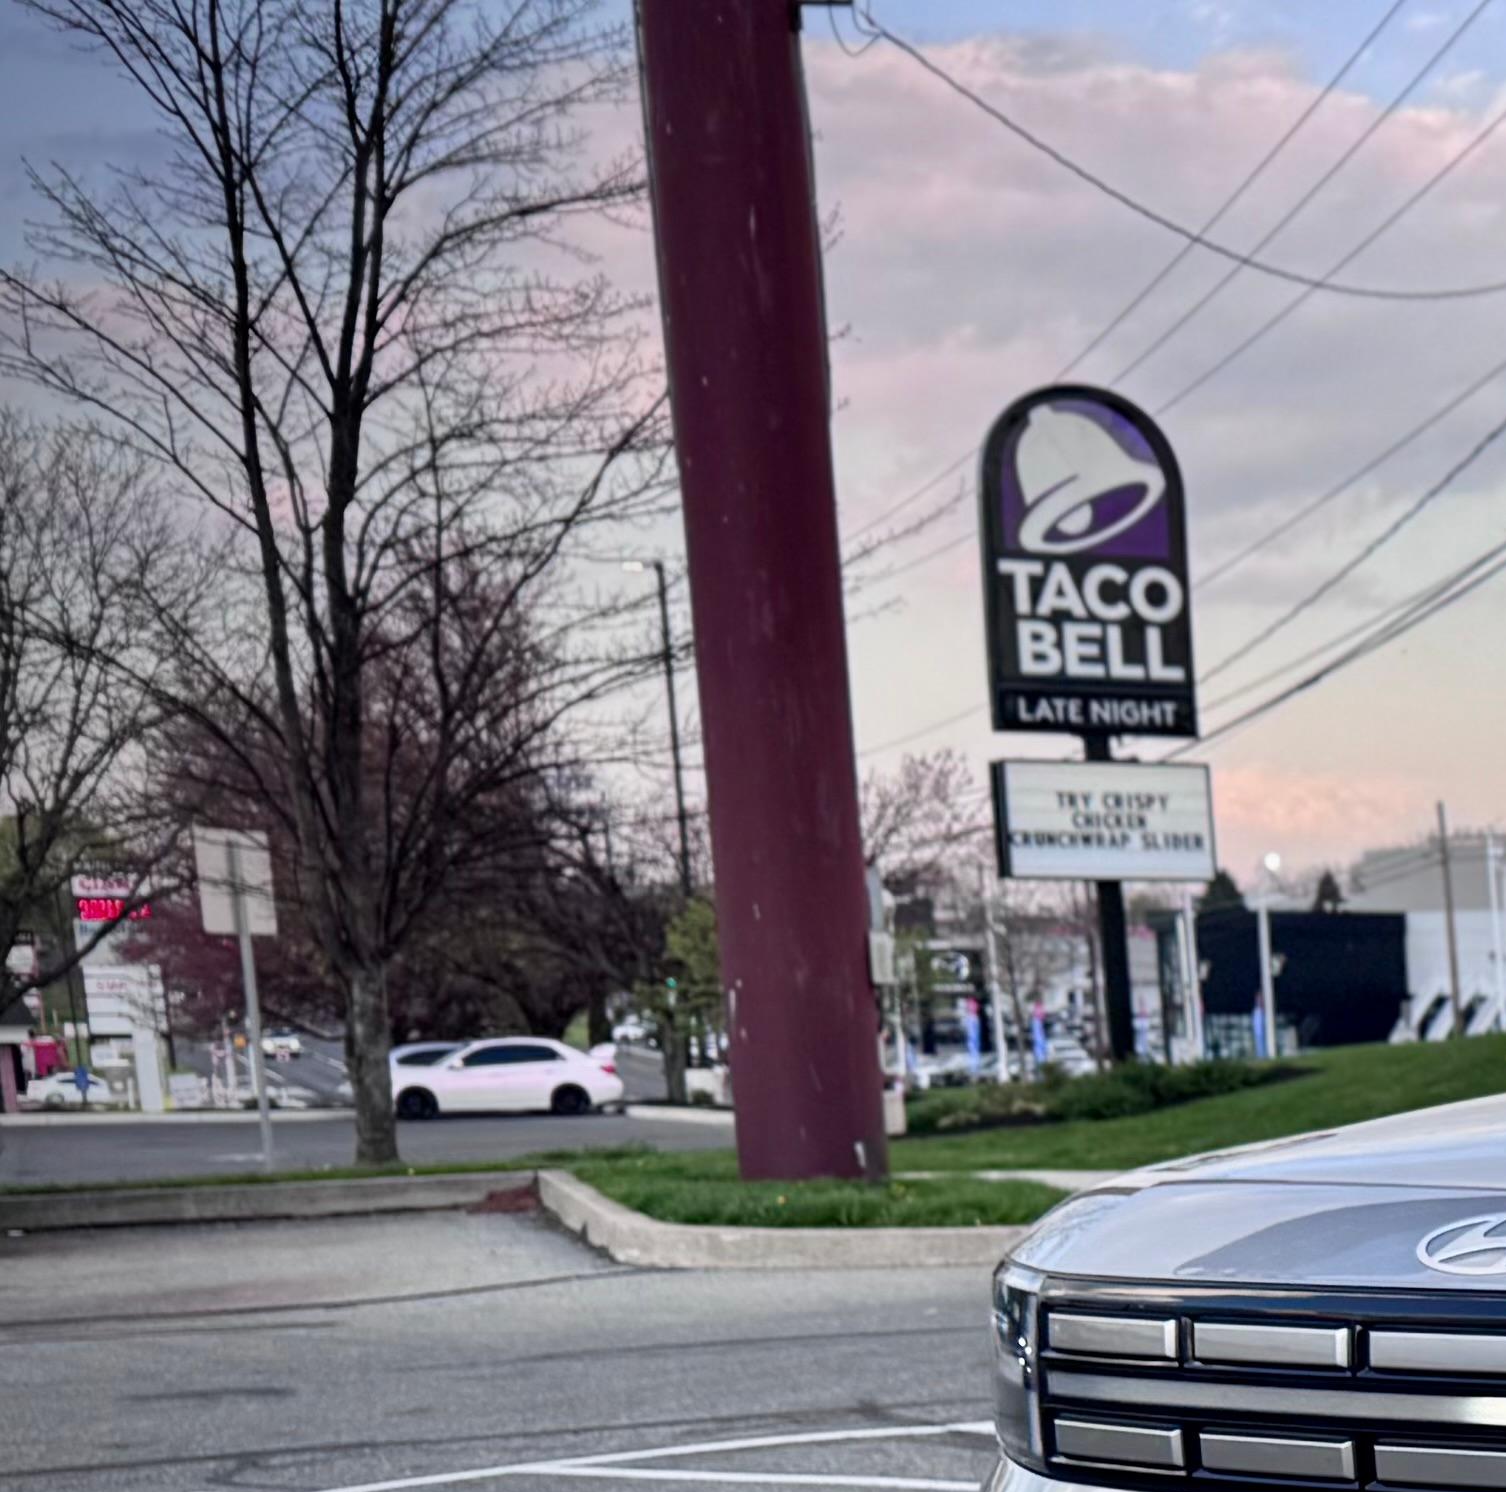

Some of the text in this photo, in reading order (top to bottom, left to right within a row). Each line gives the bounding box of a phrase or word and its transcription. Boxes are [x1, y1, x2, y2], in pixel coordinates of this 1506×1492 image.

[998, 560, 1183, 621] TACO
[1018, 621, 1185, 680] BELL
[1018, 698, 1177, 727] LATE NIGHT
[1056, 791, 1169, 811] TRY CRISPY
[1072, 812, 1147, 829] CHICKEN
[1009, 831, 1204, 851] CRUNCHWRAP SLIDER
